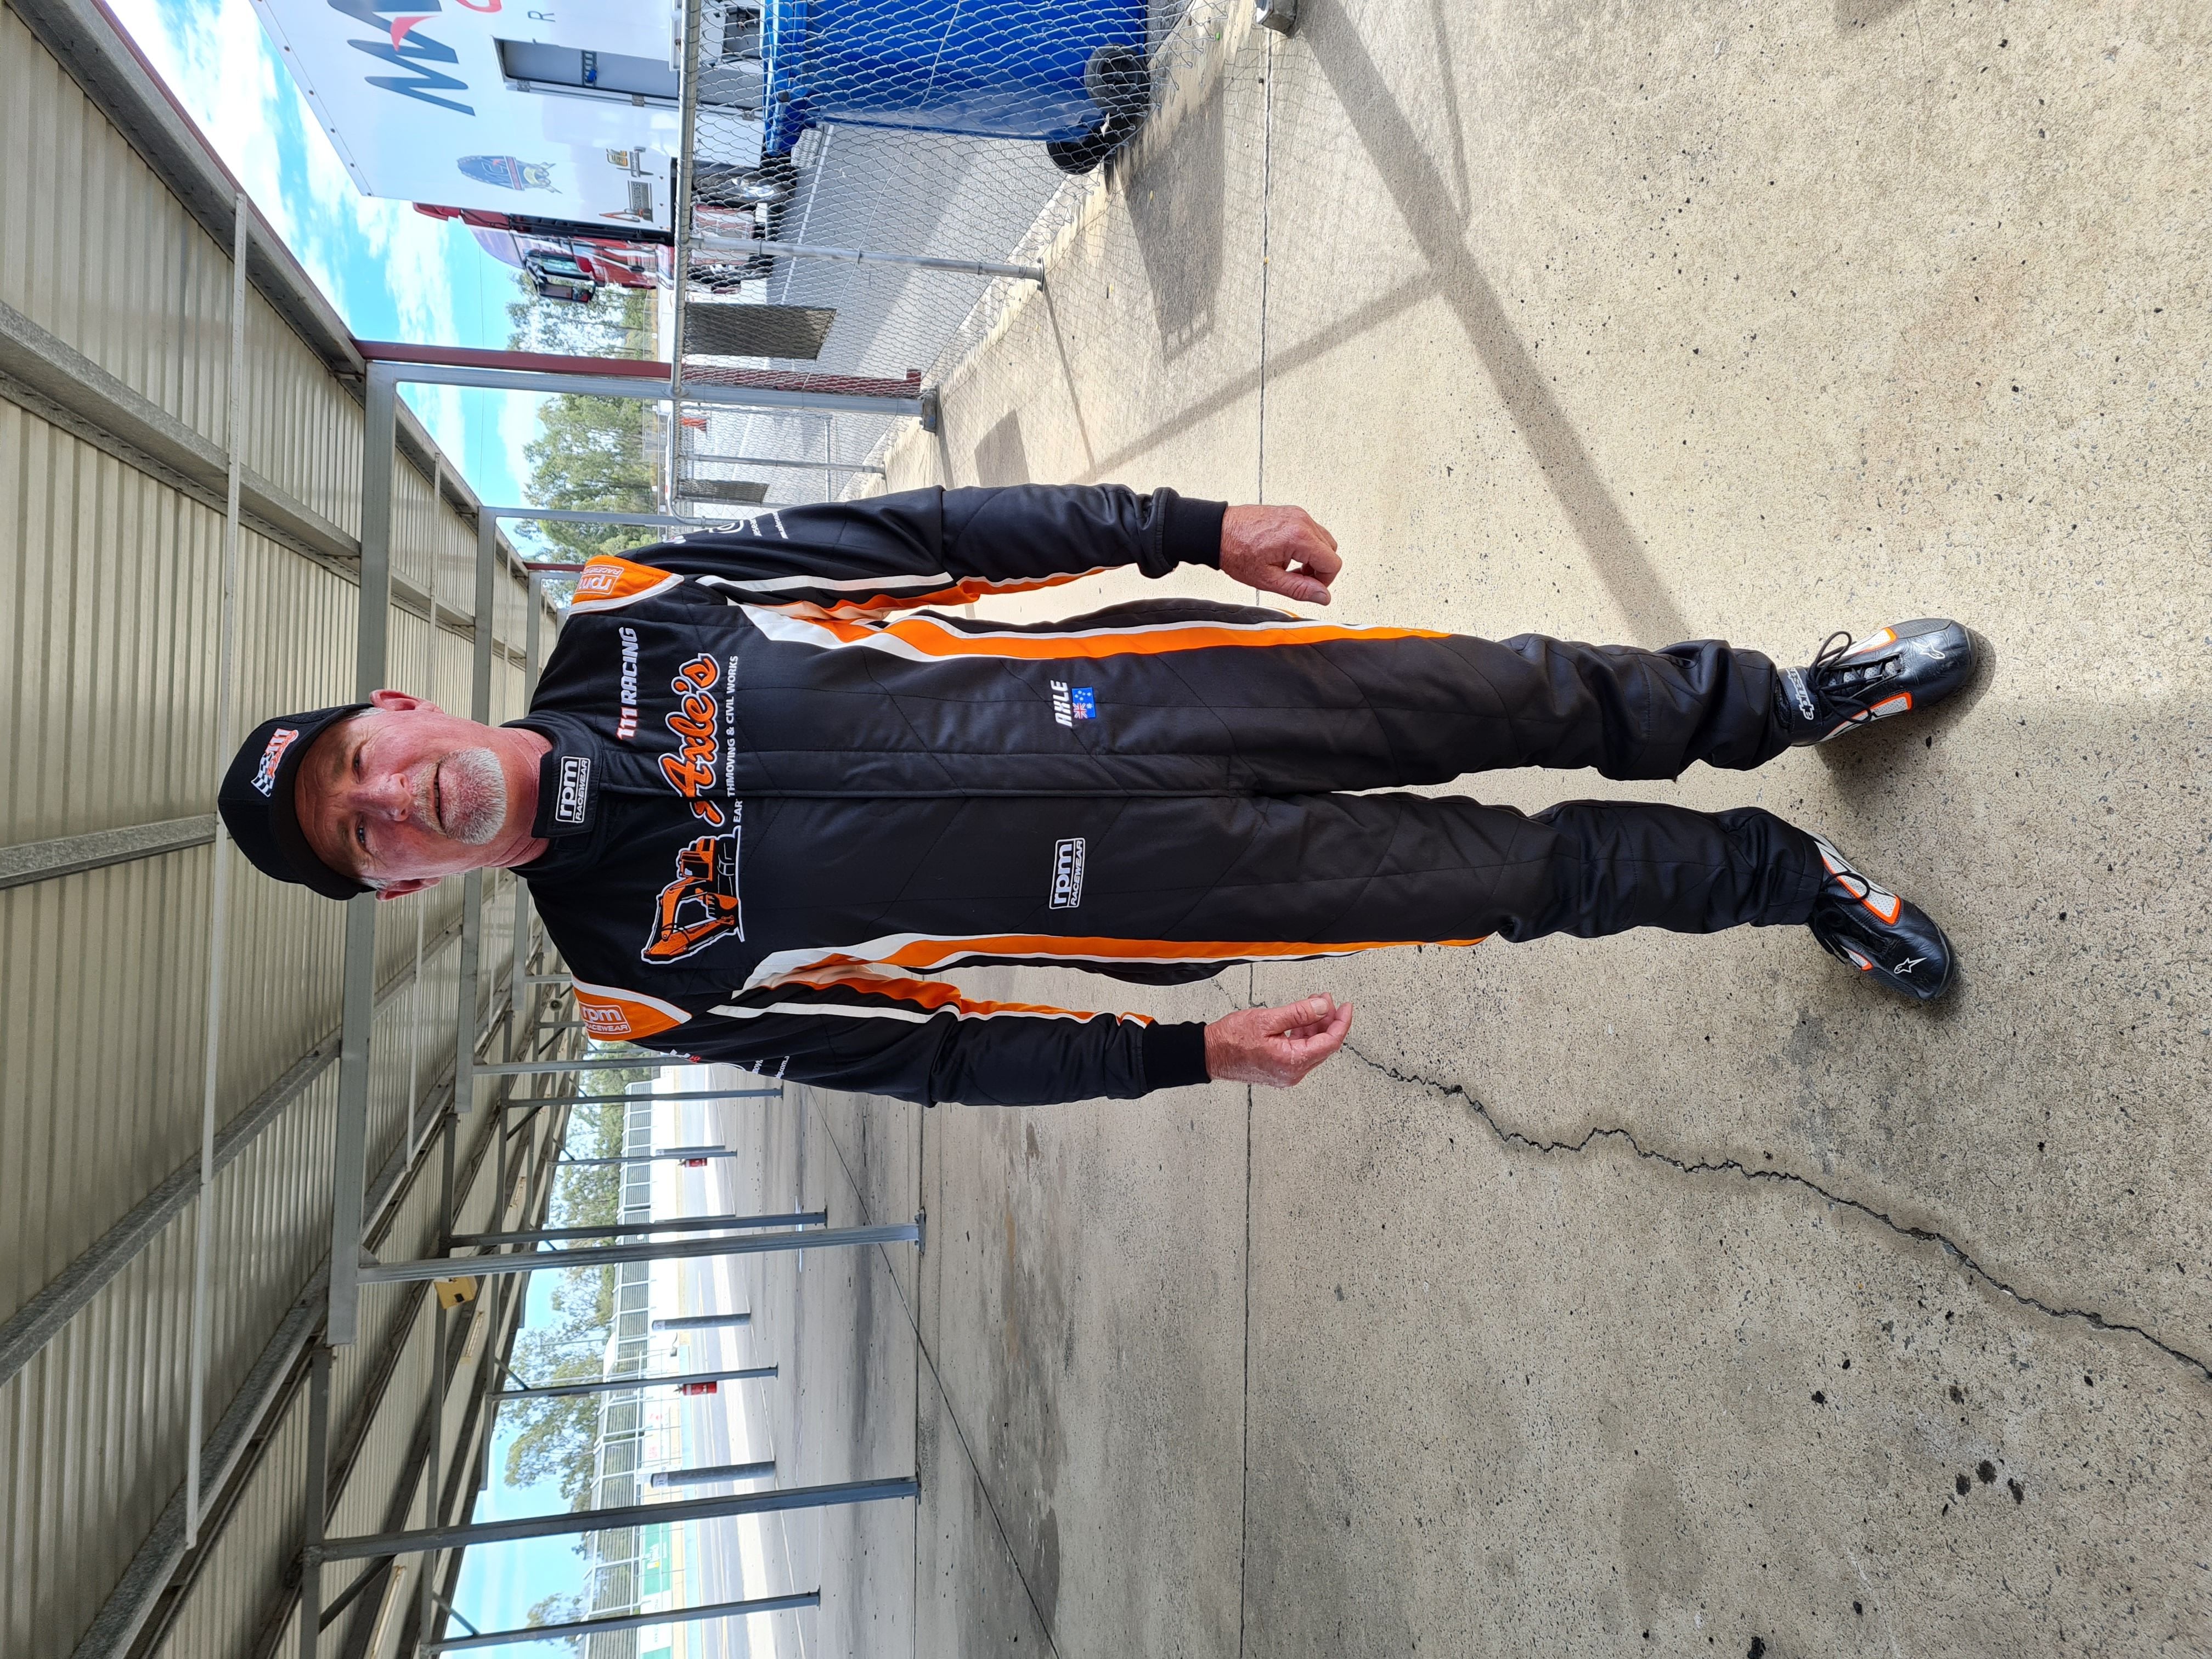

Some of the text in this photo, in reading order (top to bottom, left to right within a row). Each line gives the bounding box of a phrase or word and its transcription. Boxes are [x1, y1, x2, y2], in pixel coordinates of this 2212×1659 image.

[578, 575, 612, 590] rpm
[616, 627, 639, 740] 111 RACING
[726, 656, 738, 694] WORKS
[725, 696, 735, 724] CIVIL
[1050, 680, 1073, 727] AXLE
[658, 653, 724, 826] Axle's
[726, 726, 735, 736] &
[560, 760, 578, 817] rpm
[575, 759, 588, 821] RACEWEAR
[1054, 843, 1073, 904] rpm
[1070, 840, 1083, 905] RACEWEAR
[582, 1006, 622, 1022] rpm
